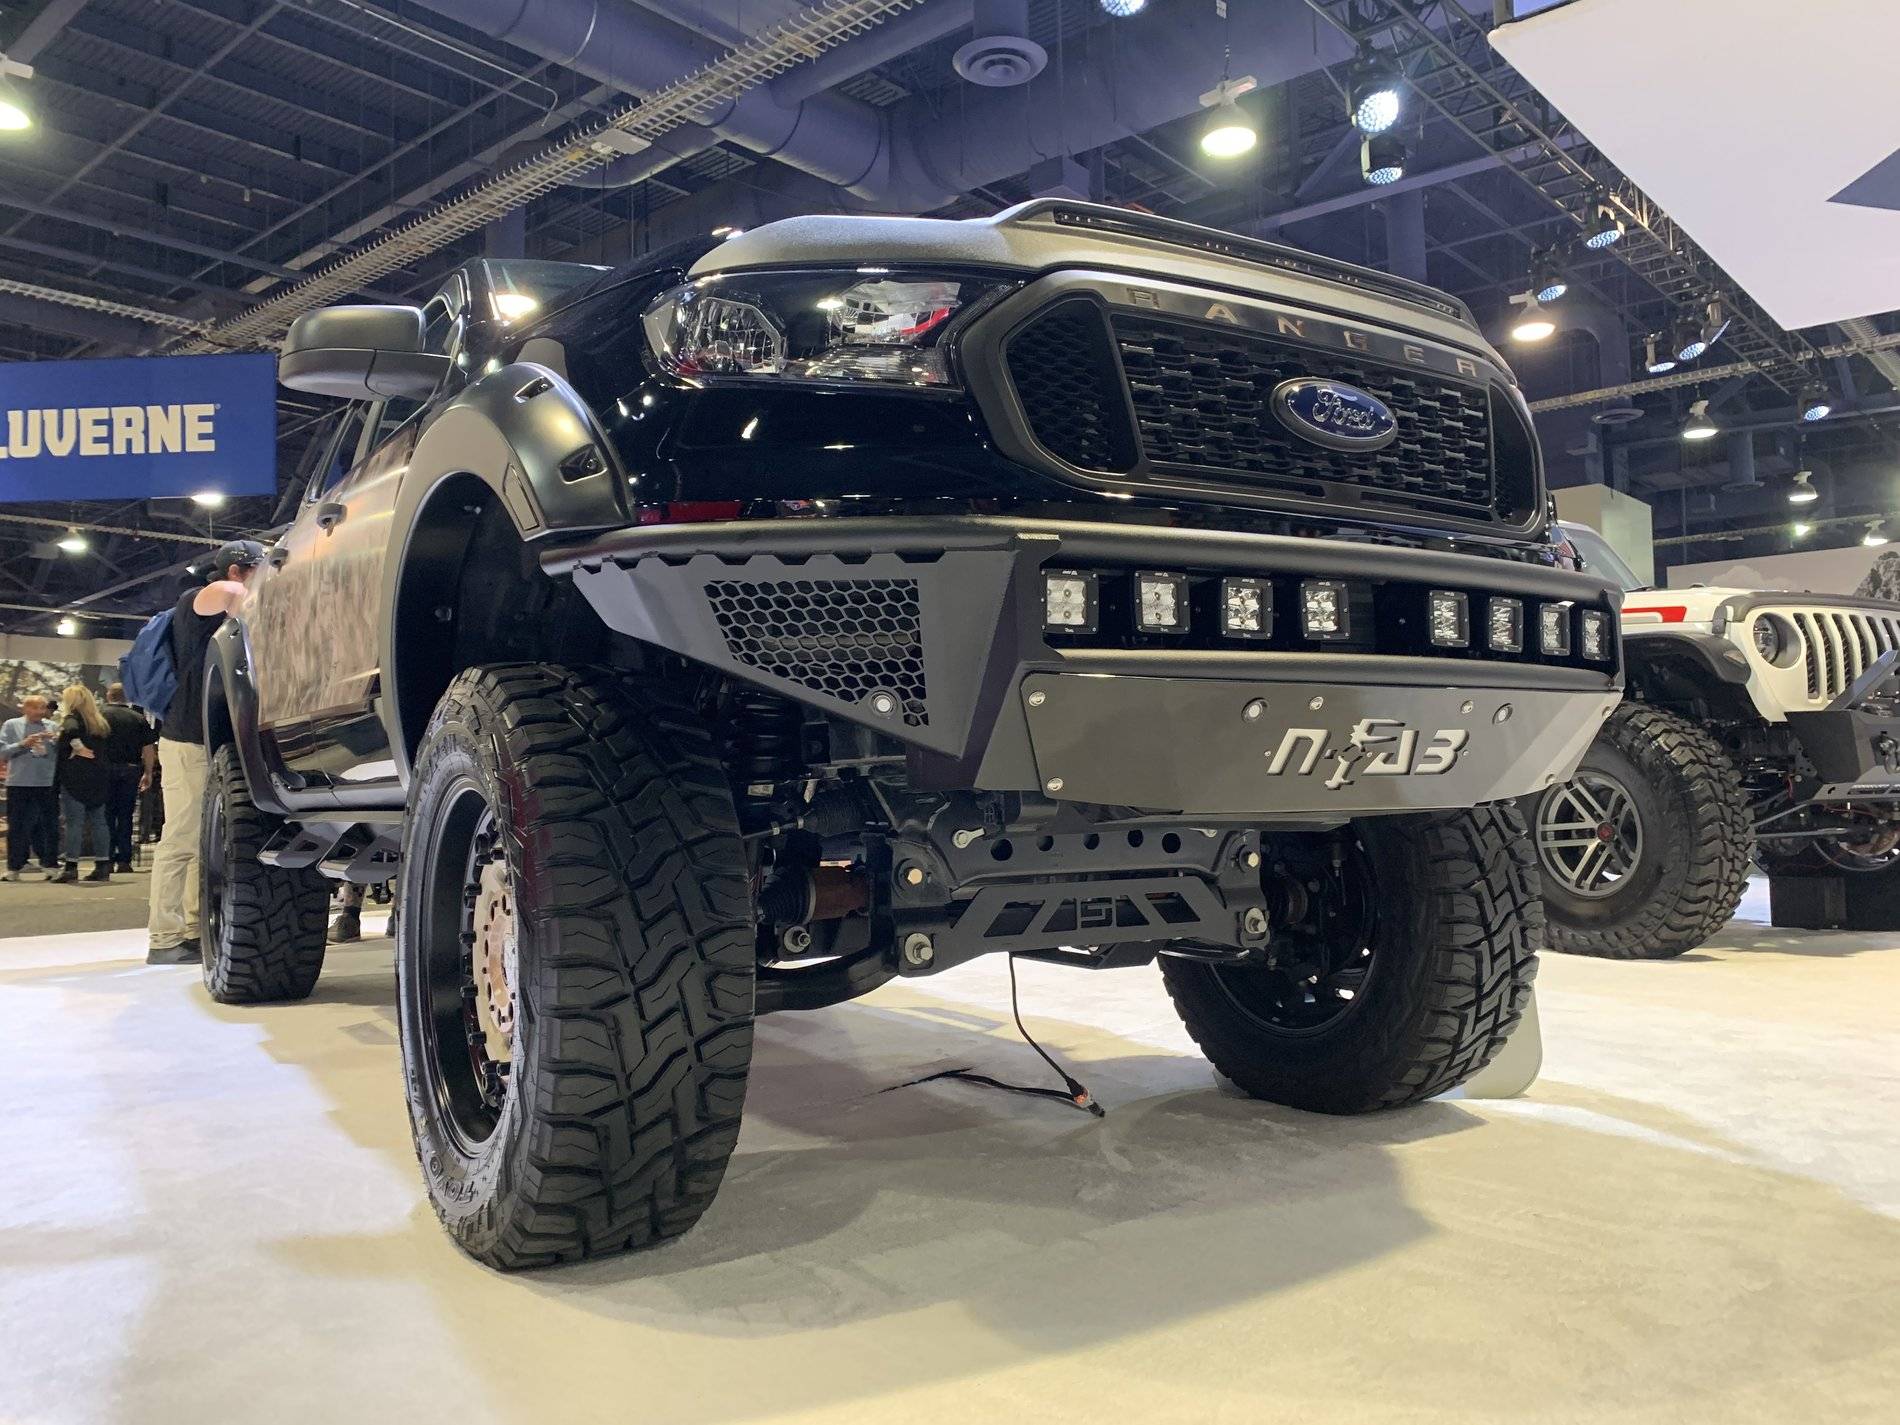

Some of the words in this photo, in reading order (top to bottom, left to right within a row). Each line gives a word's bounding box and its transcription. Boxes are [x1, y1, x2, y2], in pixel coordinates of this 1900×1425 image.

[1126, 287, 1477, 377] RANGER
[0, 403, 217, 459] UVERNE
[1312, 389, 1376, 430] Ford
